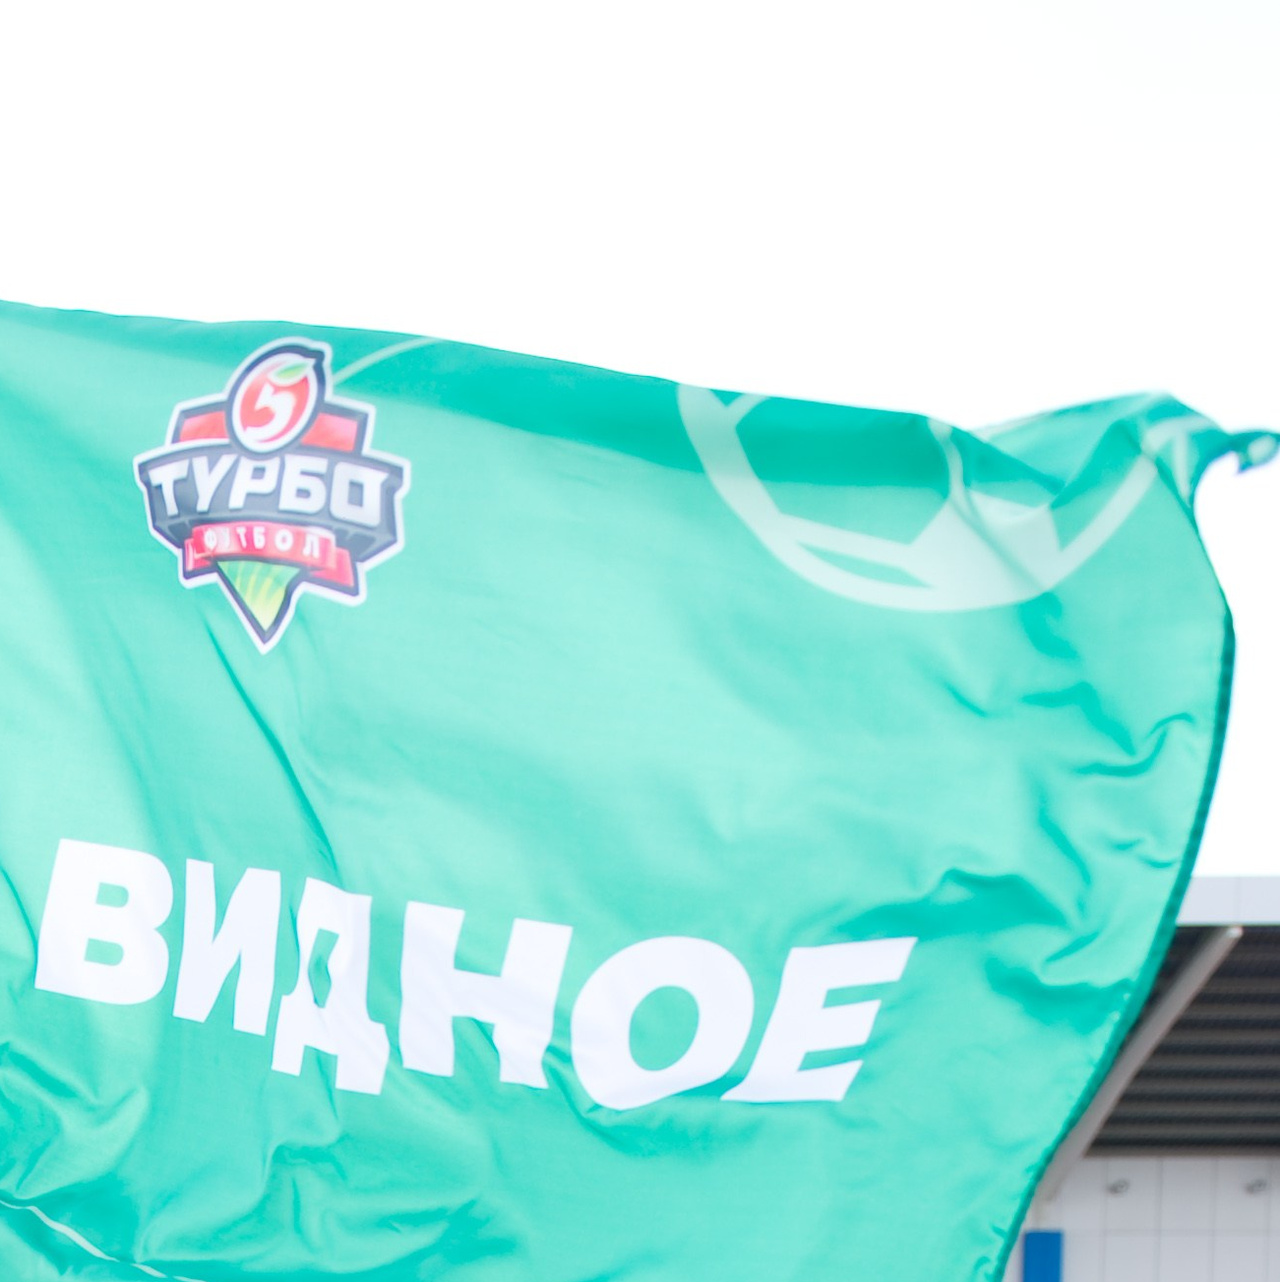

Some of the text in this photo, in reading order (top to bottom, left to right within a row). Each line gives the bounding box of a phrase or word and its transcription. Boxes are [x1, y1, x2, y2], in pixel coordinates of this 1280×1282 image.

[148, 453, 389, 527] ТУРБО
[203, 526, 320, 558] ФУТБОЛ
[34, 838, 917, 1111] ВИДНОЕ
